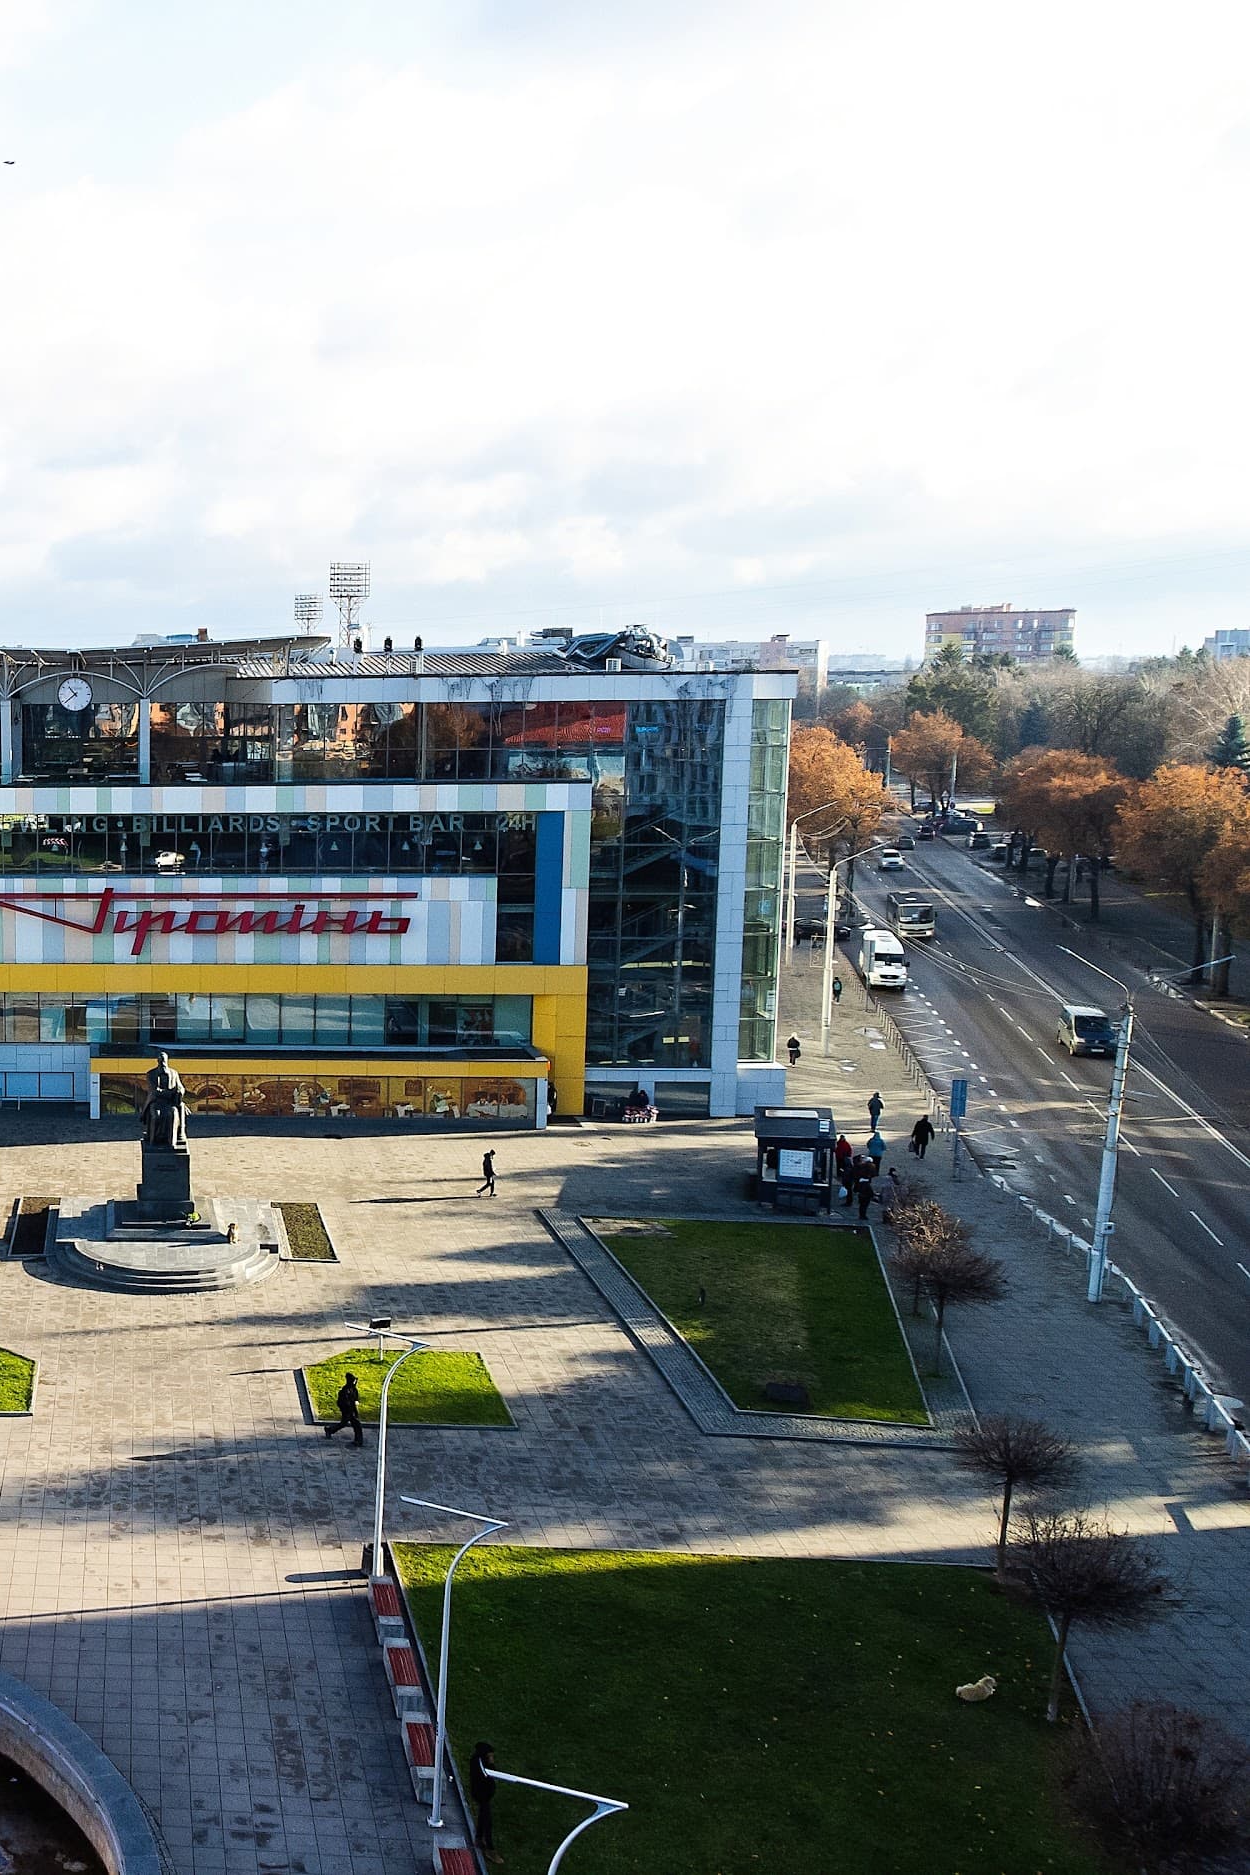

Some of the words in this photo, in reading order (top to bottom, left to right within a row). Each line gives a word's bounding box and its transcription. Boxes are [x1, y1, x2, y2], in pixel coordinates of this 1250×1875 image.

[132, 814, 280, 833] BILLIARDS
[307, 814, 399, 832] SPORT
[409, 814, 466, 832] BAR
[497, 814, 536, 831] 24H
